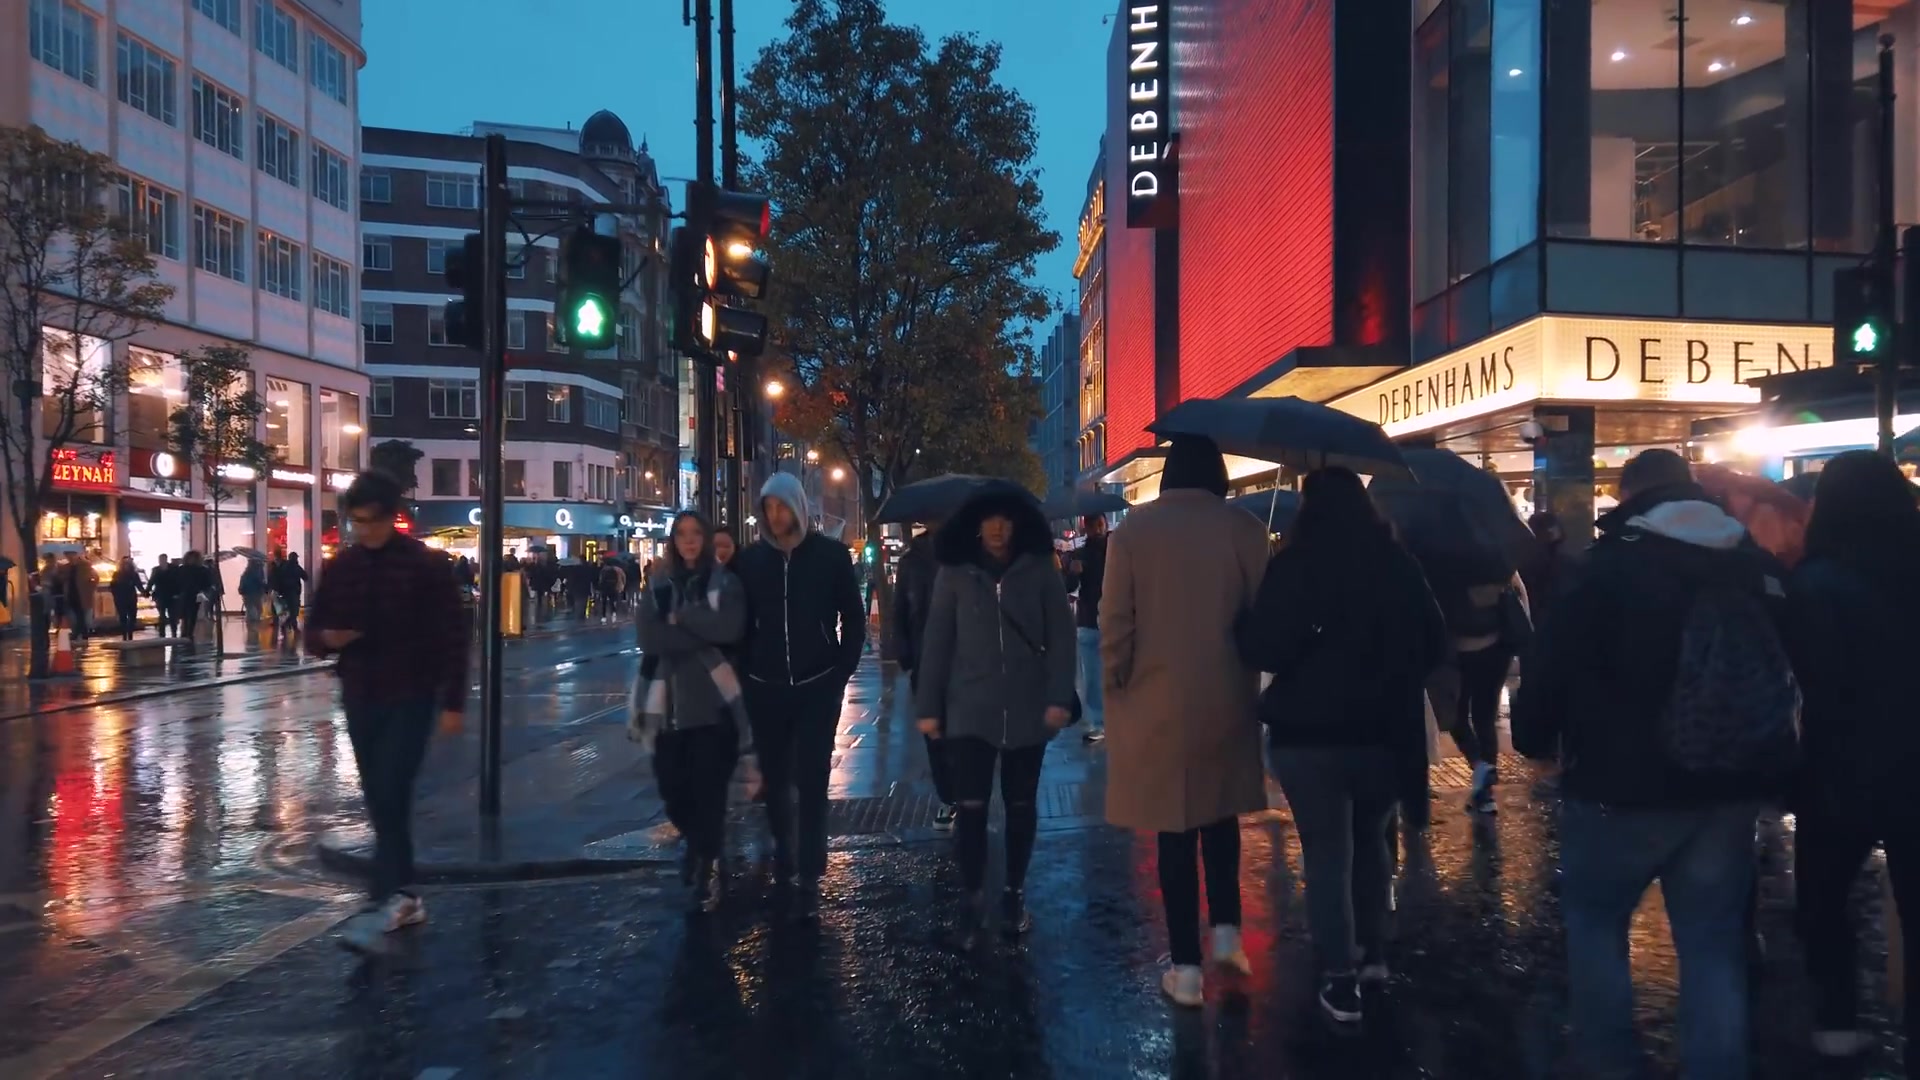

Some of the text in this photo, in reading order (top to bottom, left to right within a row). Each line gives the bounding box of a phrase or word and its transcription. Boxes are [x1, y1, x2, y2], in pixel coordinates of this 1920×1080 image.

[1130, 4, 1158, 196] DEBENH
[1379, 346, 1514, 426] DEBENHAMS
[53, 463, 114, 484] ZEYNAH
